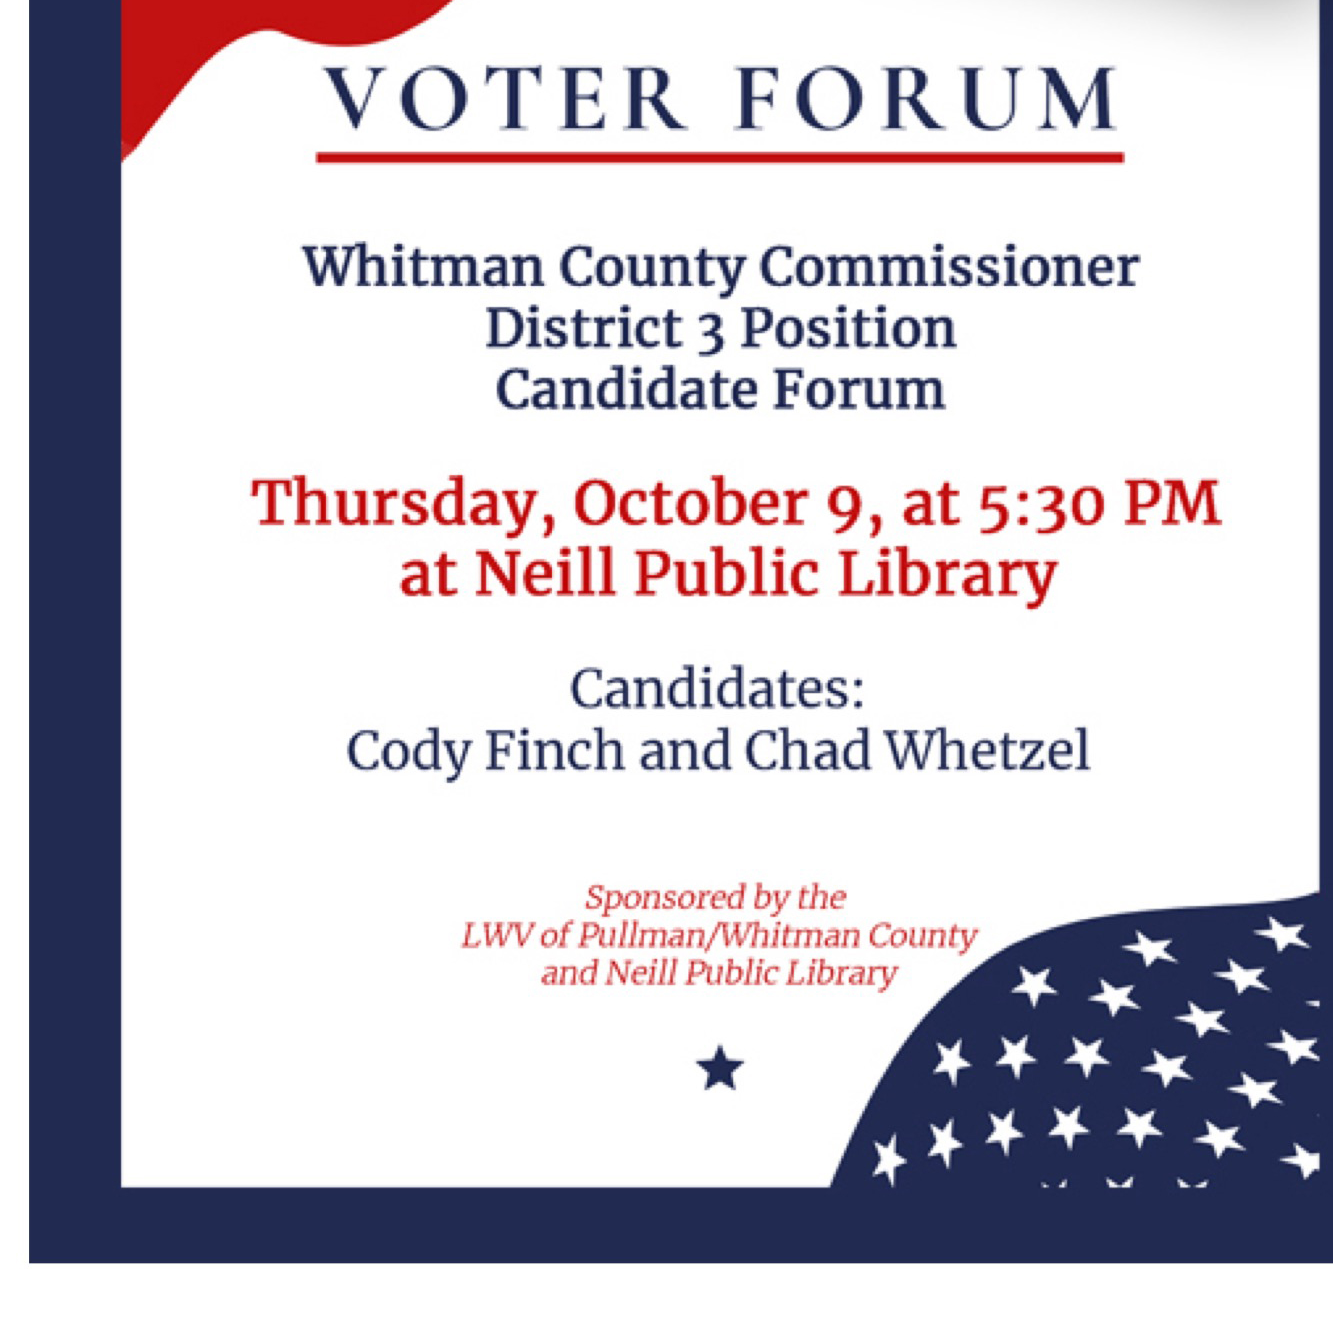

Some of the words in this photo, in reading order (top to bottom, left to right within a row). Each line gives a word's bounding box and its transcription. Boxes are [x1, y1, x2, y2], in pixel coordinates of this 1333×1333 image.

[324, 66, 685, 131] VOTER
[738, 66, 1112, 131] FORUM
[302, 242, 544, 286] Whitman
[560, 246, 747, 299] County
[760, 244, 1140, 286] Commissioner
[486, 305, 681, 348] District
[699, 314, 723, 356] 3
[741, 305, 957, 348] Position
[497, 365, 757, 409] Candidate
[774, 369, 945, 409] Forum
[252, 475, 554, 539] Thursday,
[575, 475, 809, 525] October
[828, 486, 881, 538] 9,
[904, 483, 960, 525] at
[981, 486, 1104, 533] 5:30
[1125, 479, 1222, 525] PM
[571, 665, 862, 708] Candidates:
[348, 727, 472, 783] Cody
[486, 727, 625, 770] Finch
[641, 727, 731, 770] and
[746, 727, 870, 770] Chad
[883, 727, 1089, 770] Whetzel
[586, 883, 746, 917] Sponsored
[754, 883, 790, 917] by
[799, 883, 846, 909] the
[463, 923, 534, 947] LWV
[541, 921, 573, 947] of
[580, 921, 859, 951] Pullman/Whitman
[870, 923, 978, 955] County
[542, 959, 598, 985] and
[607, 959, 677, 985] Neill
[686, 959, 778, 985] Public
[787, 959, 898, 992] Library
